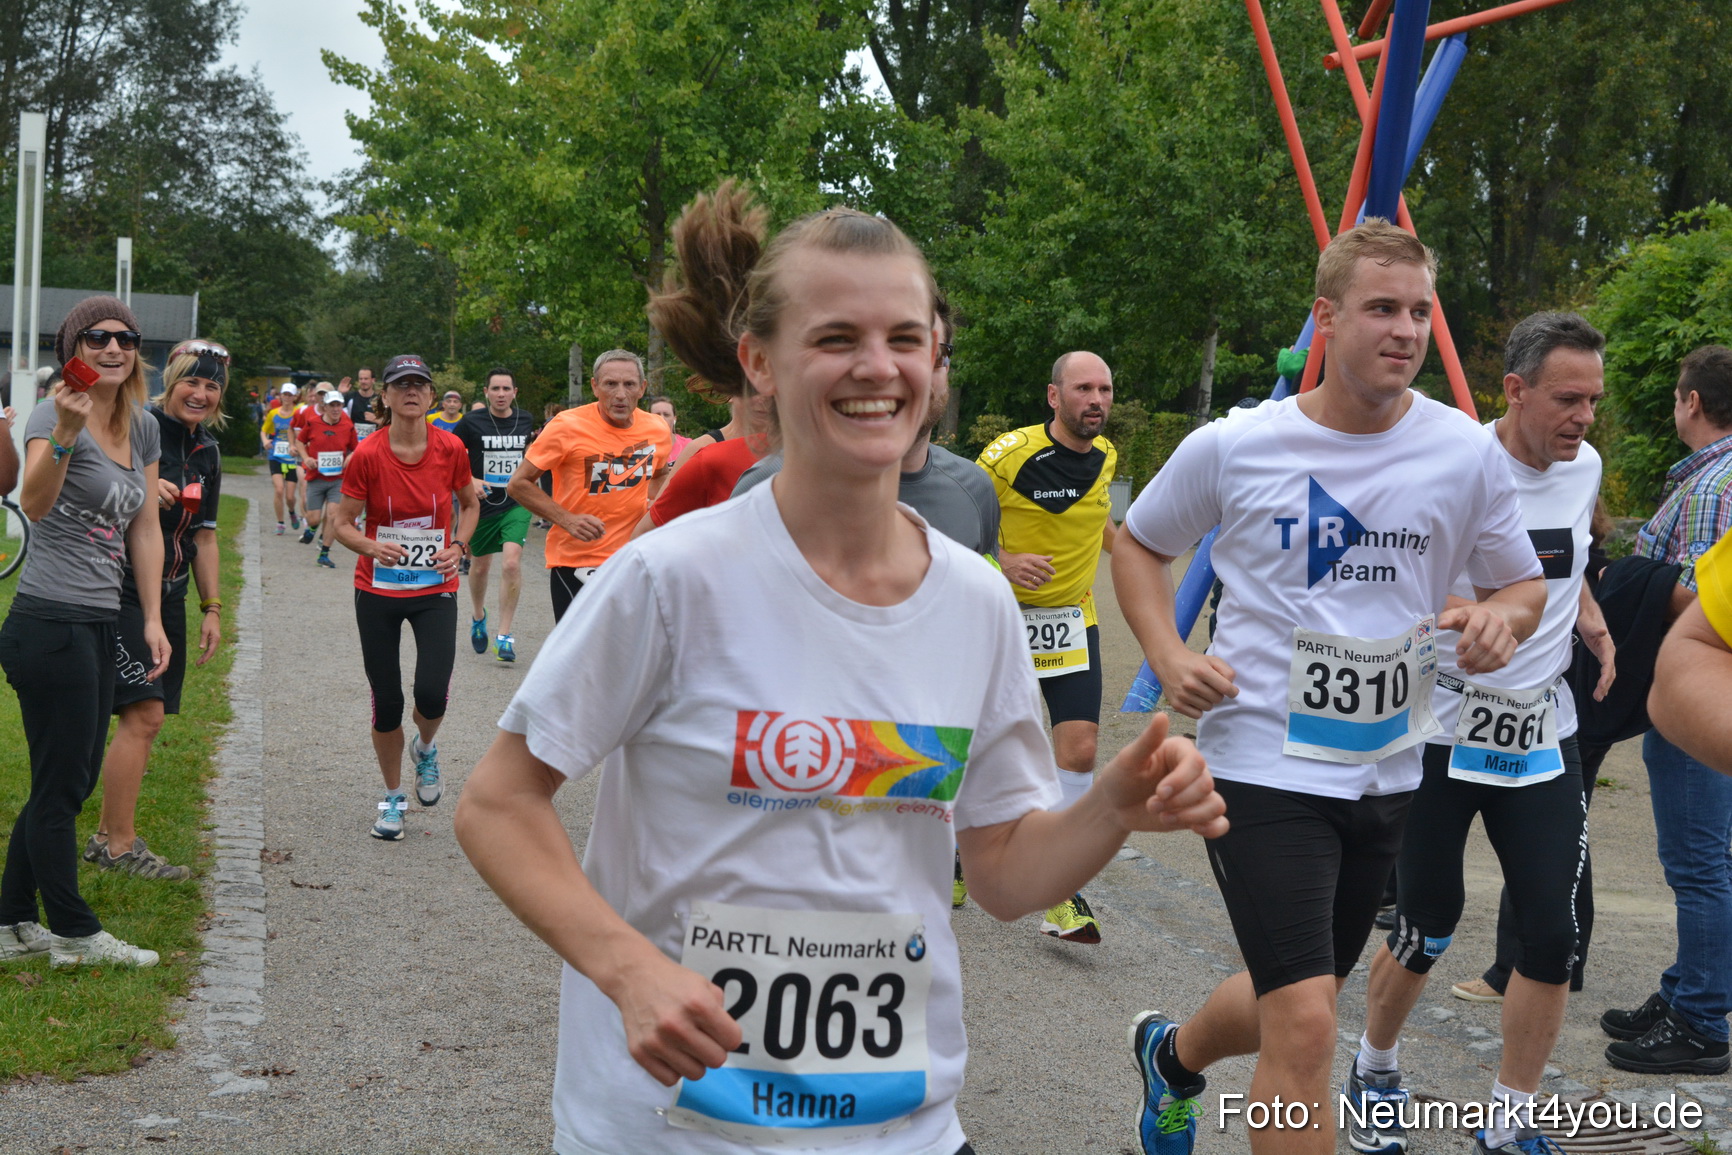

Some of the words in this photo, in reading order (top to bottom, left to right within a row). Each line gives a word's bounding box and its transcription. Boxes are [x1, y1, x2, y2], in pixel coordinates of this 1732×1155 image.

[481, 435, 526, 449] THULE
[101, 481, 145, 514] NO
[1033, 489, 1065, 500] Bernd
[1066, 489, 1080, 498] W.
[403, 521, 422, 529] DEHN
[377, 532, 399, 541] PARTL
[401, 534, 433, 542] Neumarkt
[397, 572, 420, 582] Gabi
[1327, 560, 1397, 582] Team
[1035, 612, 1070, 621] Neumarkt
[1297, 639, 1342, 659] PARTL
[1034, 656, 1064, 668] Bernd
[1303, 661, 1409, 716] 3310
[1472, 690, 1504, 705] ARTL
[1467, 706, 1546, 750] 2661
[691, 926, 779, 956] PARTL
[787, 936, 897, 958] Neumarkt
[711, 967, 906, 1060] 2063
[752, 1082, 856, 1119] Hanna
